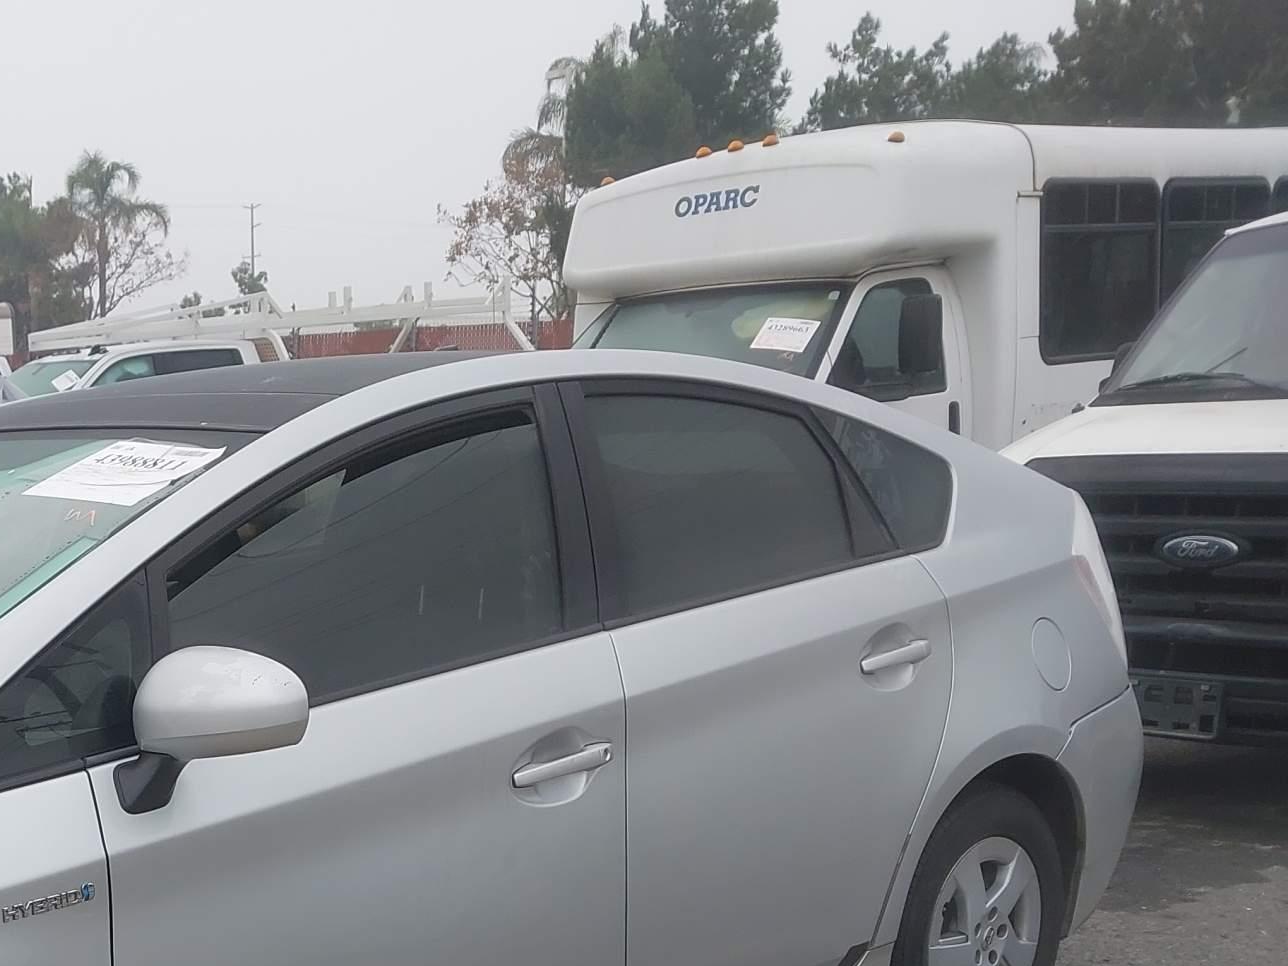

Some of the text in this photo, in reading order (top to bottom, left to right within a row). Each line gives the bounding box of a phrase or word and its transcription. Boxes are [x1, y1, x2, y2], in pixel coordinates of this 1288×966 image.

[674, 184, 760, 218] OPARC
[1177, 540, 1219, 558] Ford
[1, 889, 82, 923] HYBRID
